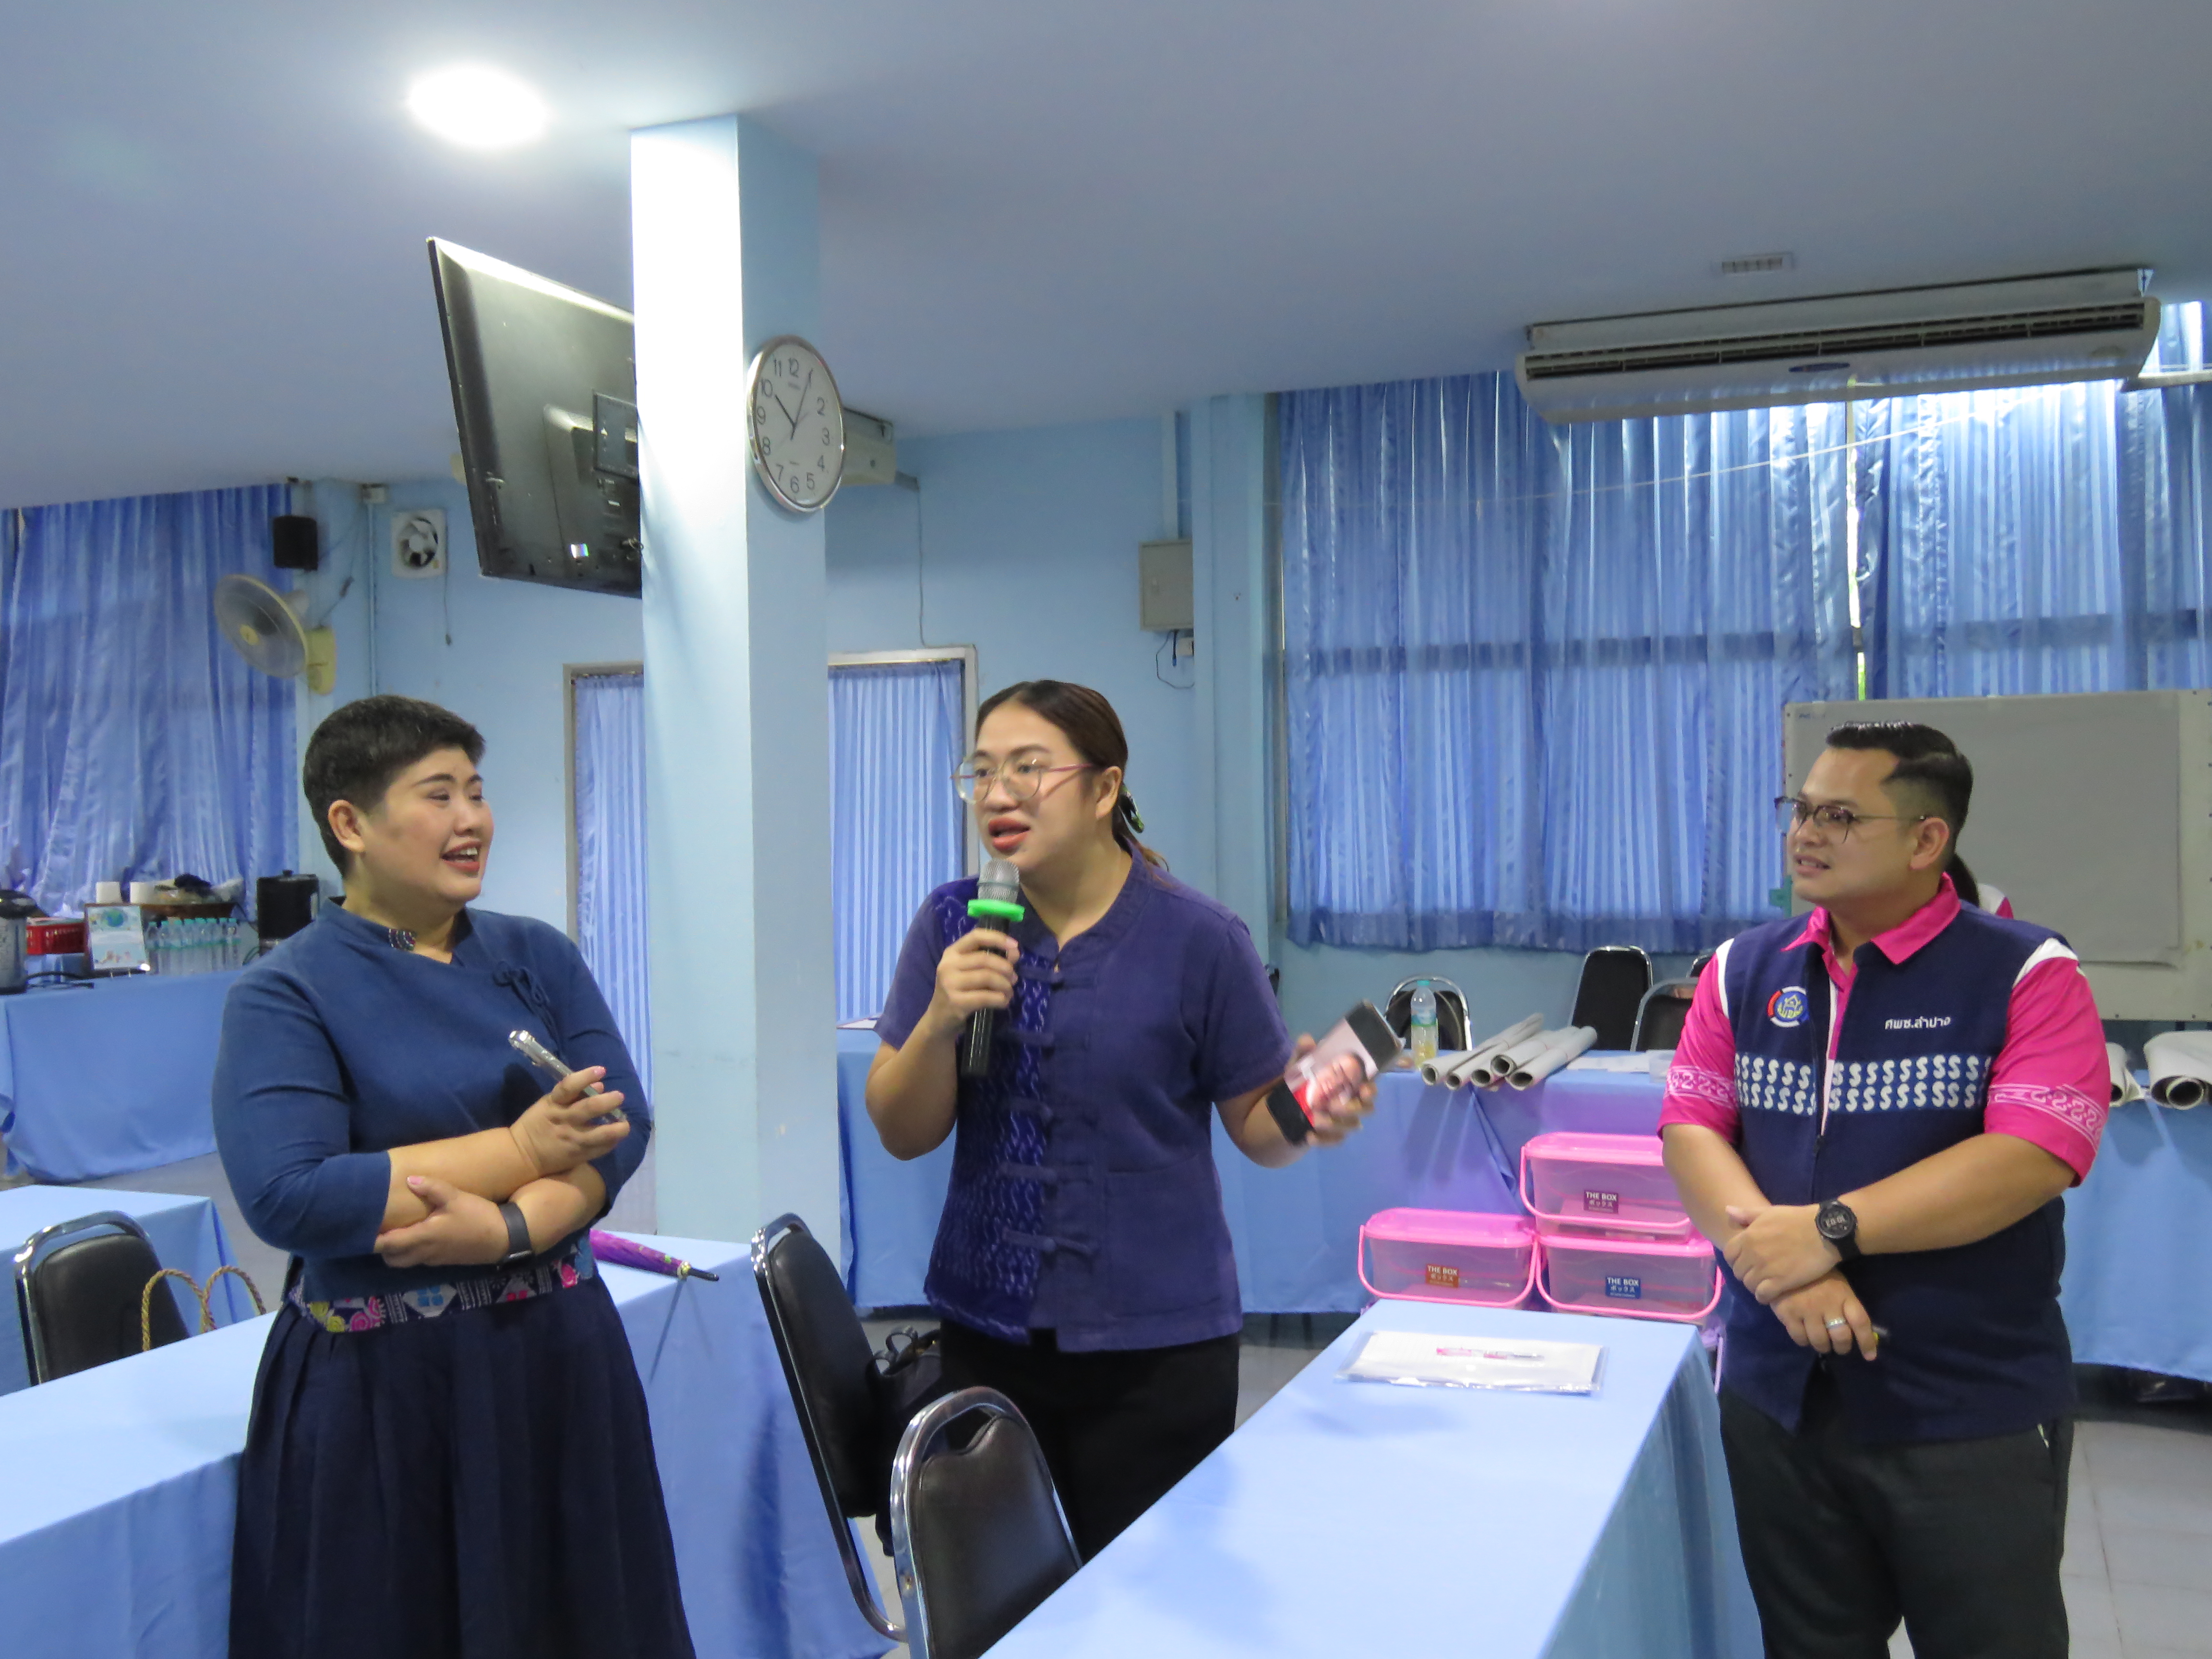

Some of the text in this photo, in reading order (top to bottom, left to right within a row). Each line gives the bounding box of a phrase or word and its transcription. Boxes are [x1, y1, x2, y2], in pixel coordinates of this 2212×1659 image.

[773, 358, 782, 378] 11
[788, 357, 799, 378] 12
[761, 378, 773, 398] 10
[757, 406, 766, 425] 9
[816, 397, 826, 416] 2
[762, 436, 771, 456] 8
[822, 427, 830, 446] 3
[775, 463, 784, 482] 7
[817, 455, 825, 472] 4
[790, 476, 800, 494] 6
[806, 471, 815, 491] 5
[1586, 1191, 1617, 1202] THE BOX
[1428, 1265, 1458, 1275] THE BOX
[1607, 1277, 1639, 1286] THE BOX
